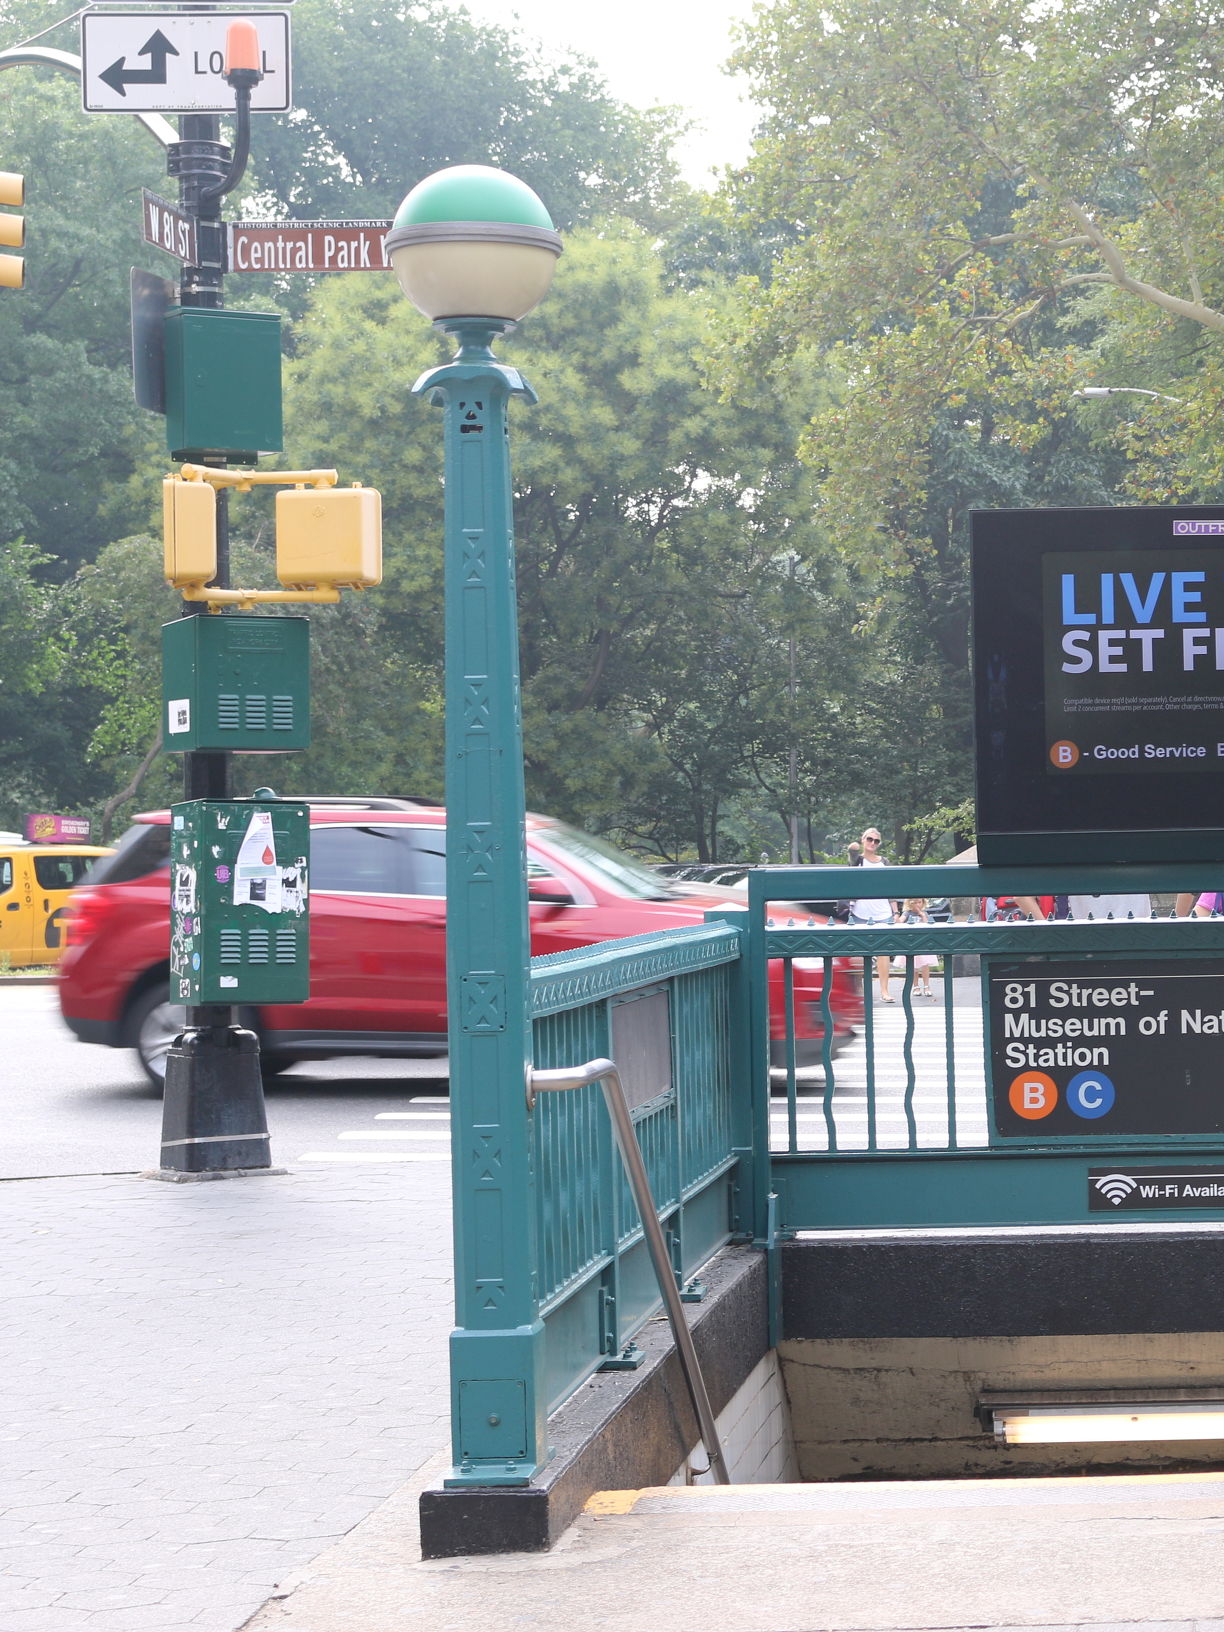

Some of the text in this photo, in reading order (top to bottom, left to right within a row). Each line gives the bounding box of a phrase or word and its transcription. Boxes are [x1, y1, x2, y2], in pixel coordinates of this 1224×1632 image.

[194, 50, 275, 75] LOL
[149, 203, 190, 260] W 81 ST
[237, 232, 315, 270] Central
[324, 232, 371, 269] Park
[1061, 571, 1208, 625] LIVE
[1061, 628, 1165, 674] SET
[1058, 746, 1073, 763] B
[1094, 744, 1139, 759] Good
[1144, 743, 1207, 758] Service
[1004, 981, 1155, 1009] 81 Street-
[1004, 1012, 1126, 1038] Museum
[1138, 1009, 1169, 1036] of
[1005, 1042, 1109, 1069] Station
[1023, 1080, 1103, 1109] B C
[1139, 1184, 1179, 1199] Wi-Fi
